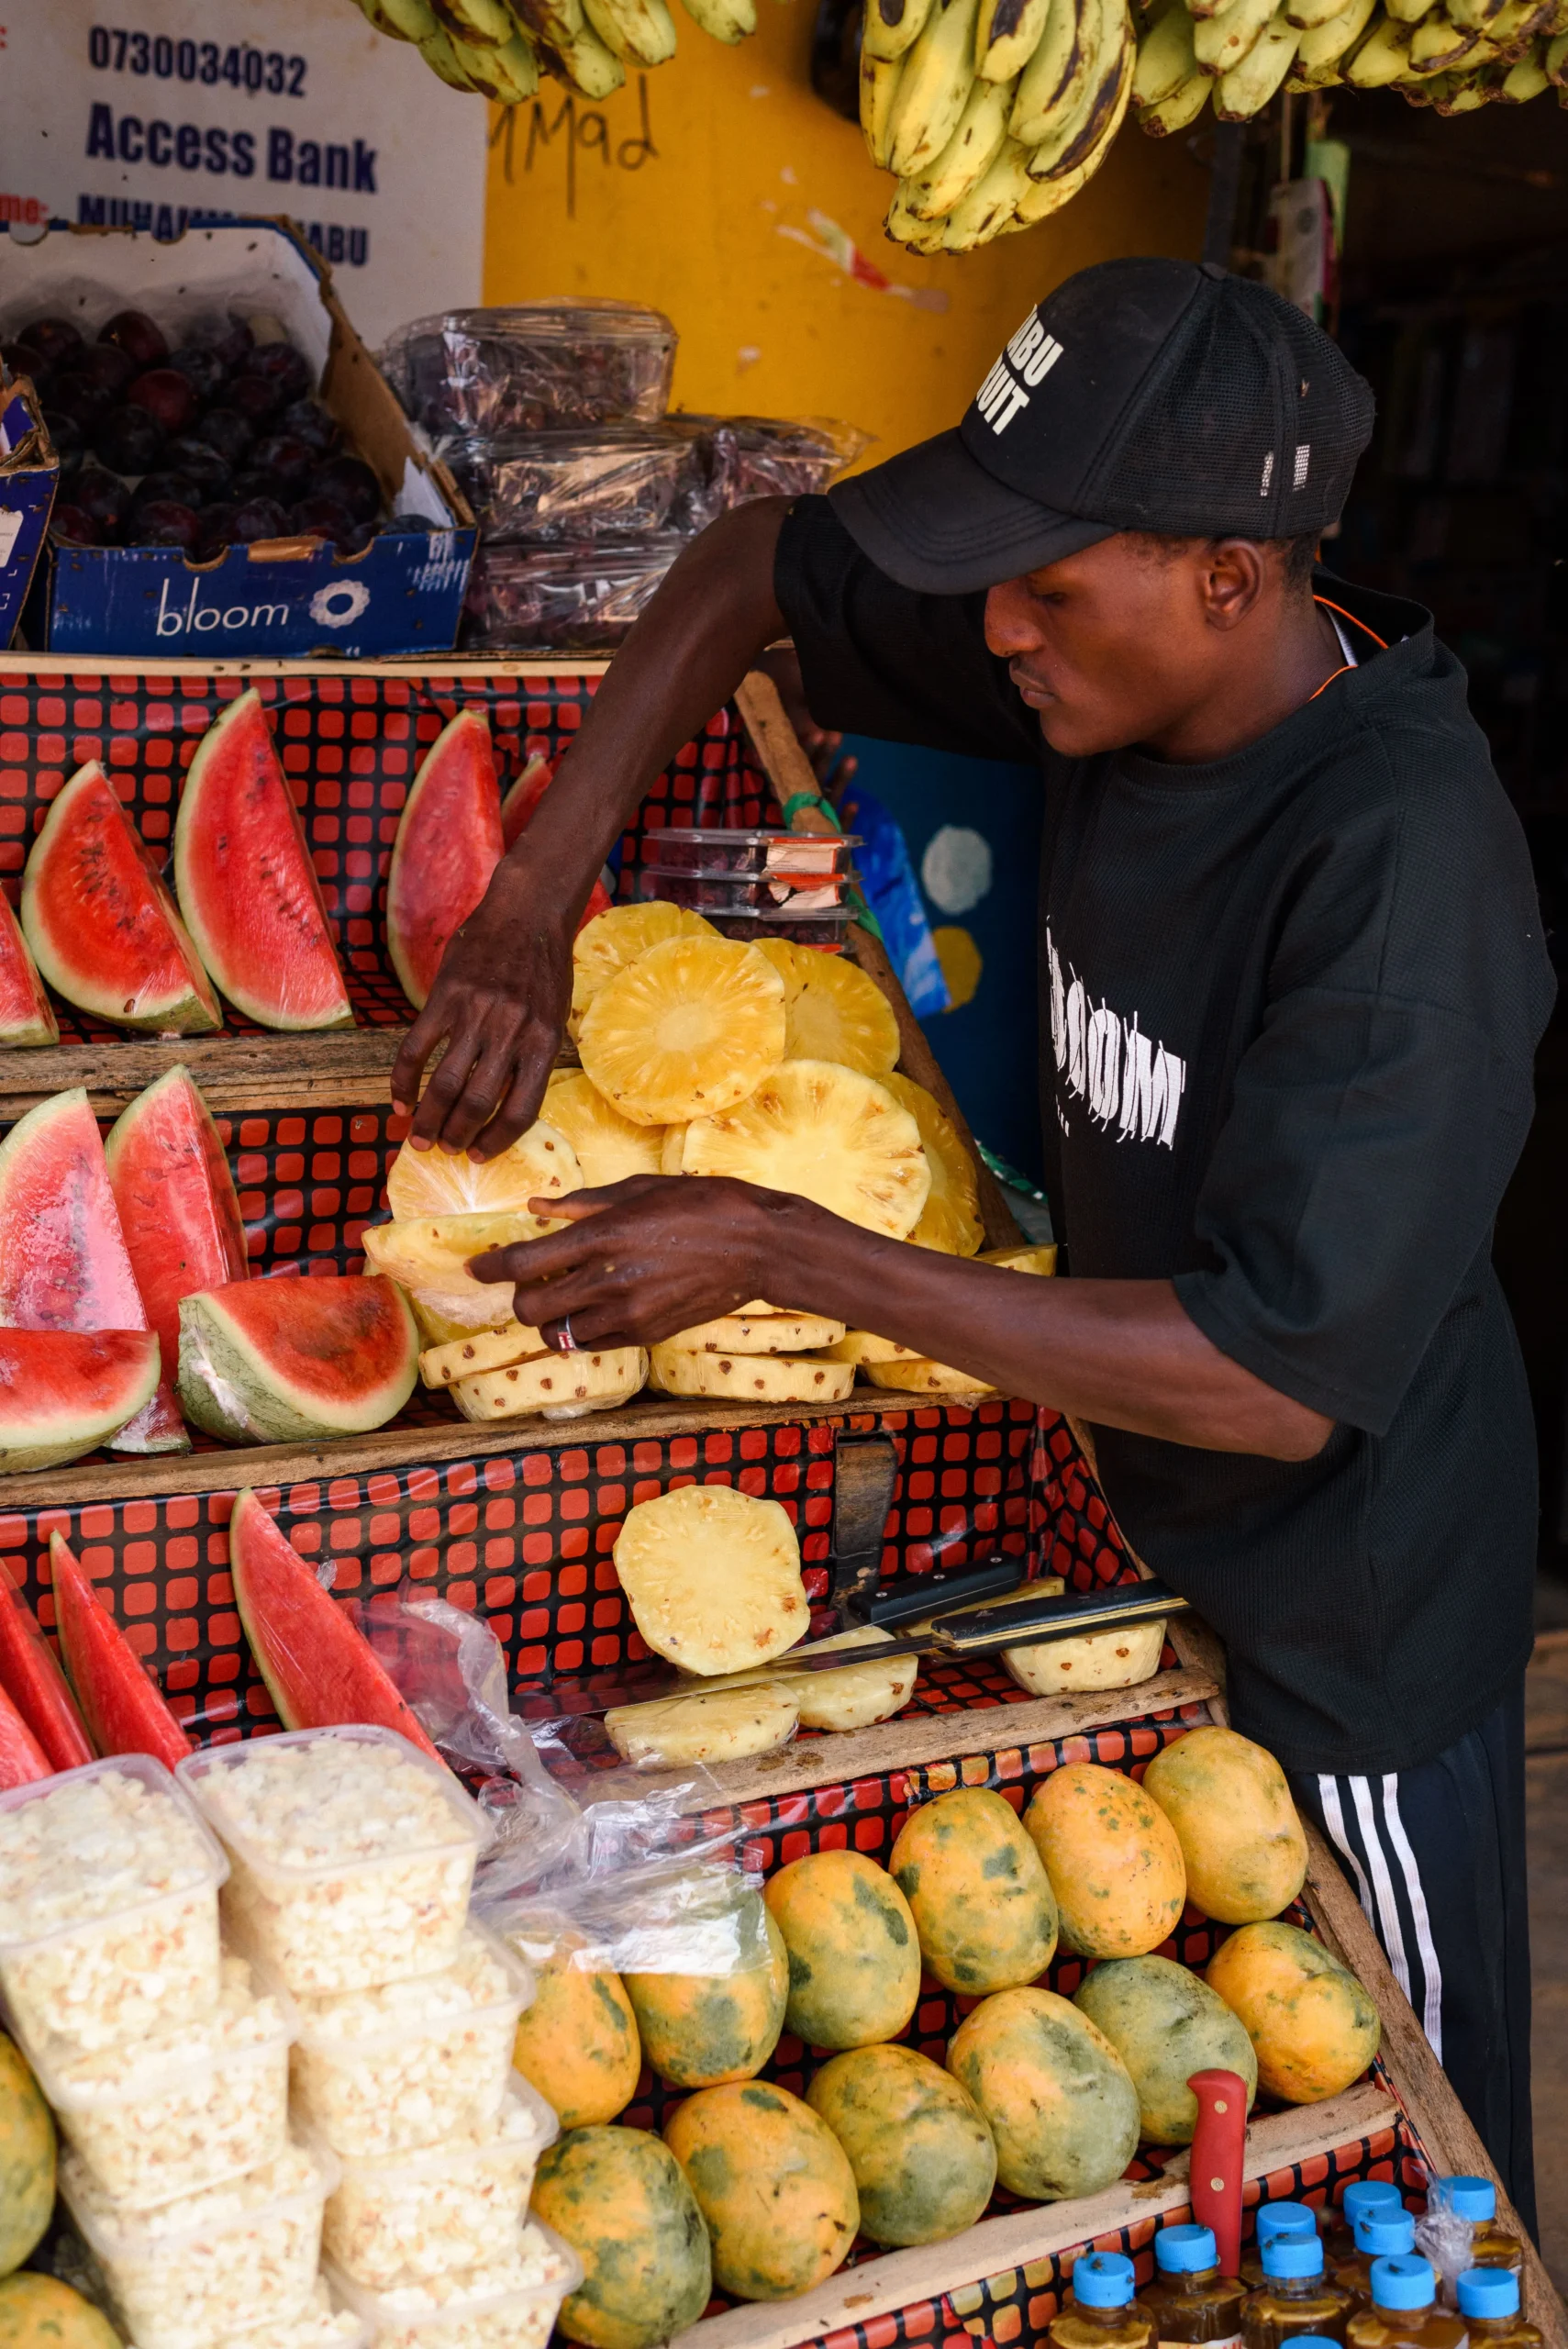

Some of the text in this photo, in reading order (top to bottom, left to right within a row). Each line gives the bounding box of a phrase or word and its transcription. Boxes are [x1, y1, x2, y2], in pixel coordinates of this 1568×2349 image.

[89, 26, 307, 97] 0730034032
[85, 102, 378, 194] Access Bank
[1006, 304, 1064, 387] ABU
[157, 577, 289, 636] bloom
